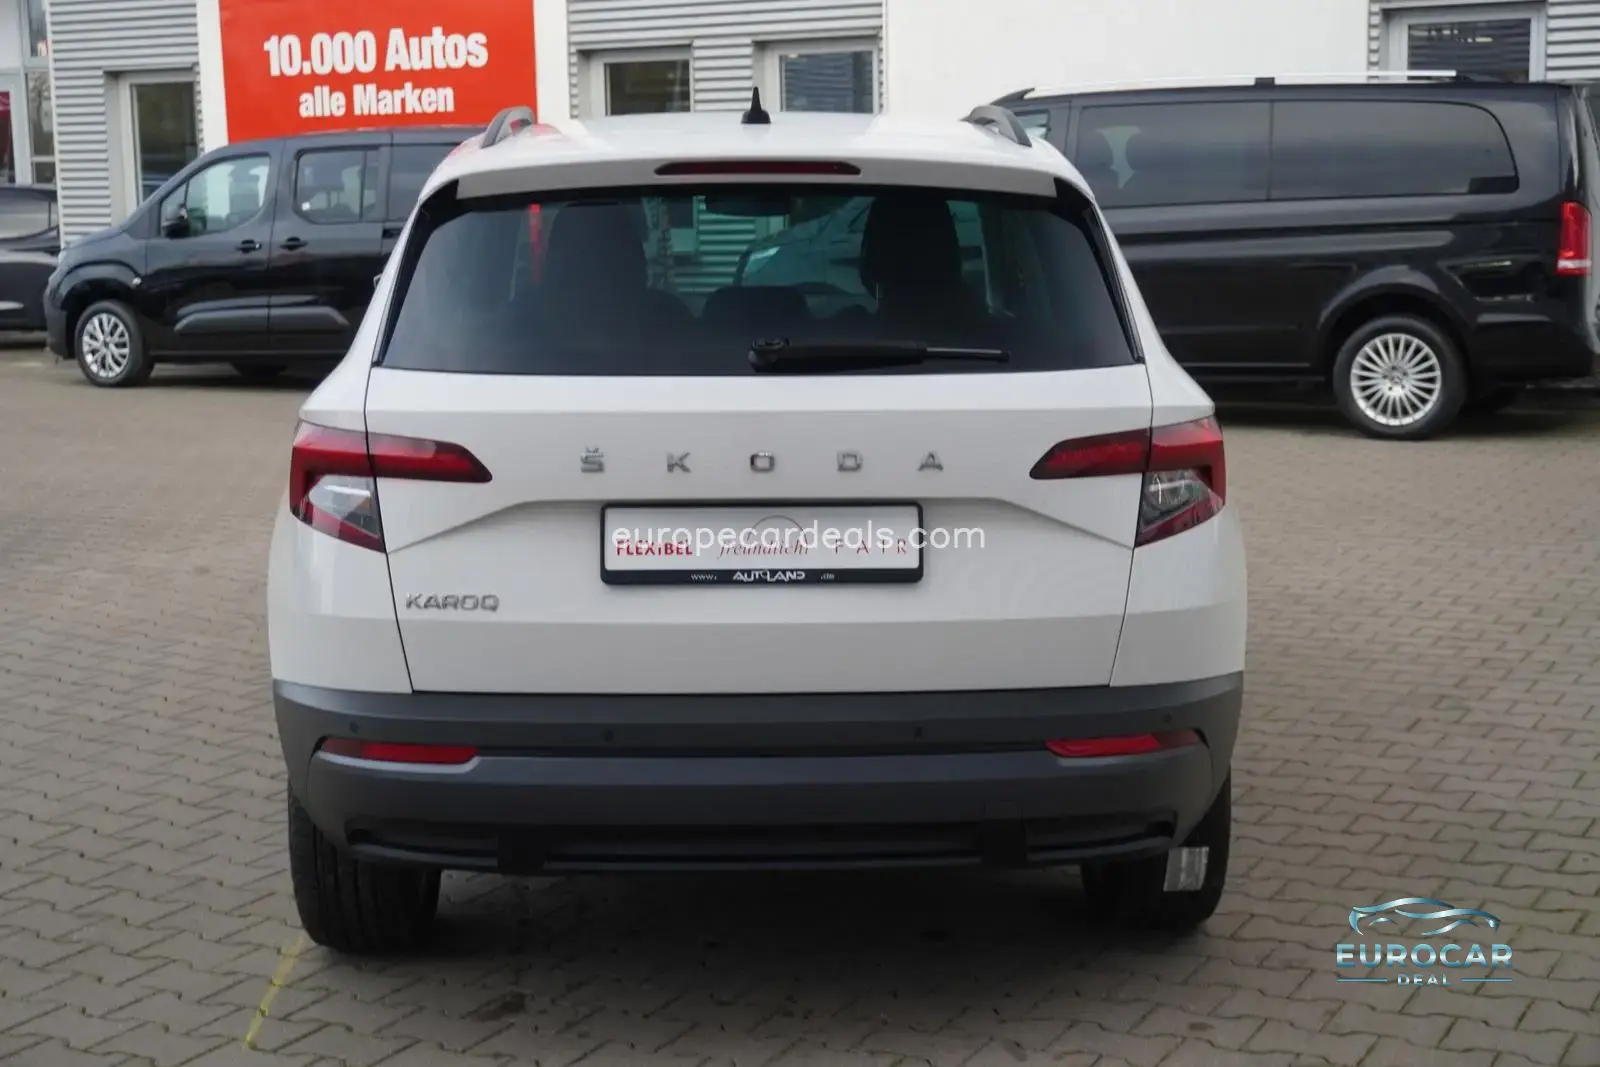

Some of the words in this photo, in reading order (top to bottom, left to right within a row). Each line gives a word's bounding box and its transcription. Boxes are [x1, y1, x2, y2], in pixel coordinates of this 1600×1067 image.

[263, 31, 376, 76] 10.000
[385, 26, 488, 71] Autos
[299, 85, 345, 117] alle
[353, 82, 454, 115] Marken
[405, 593, 500, 612] KAROQ
